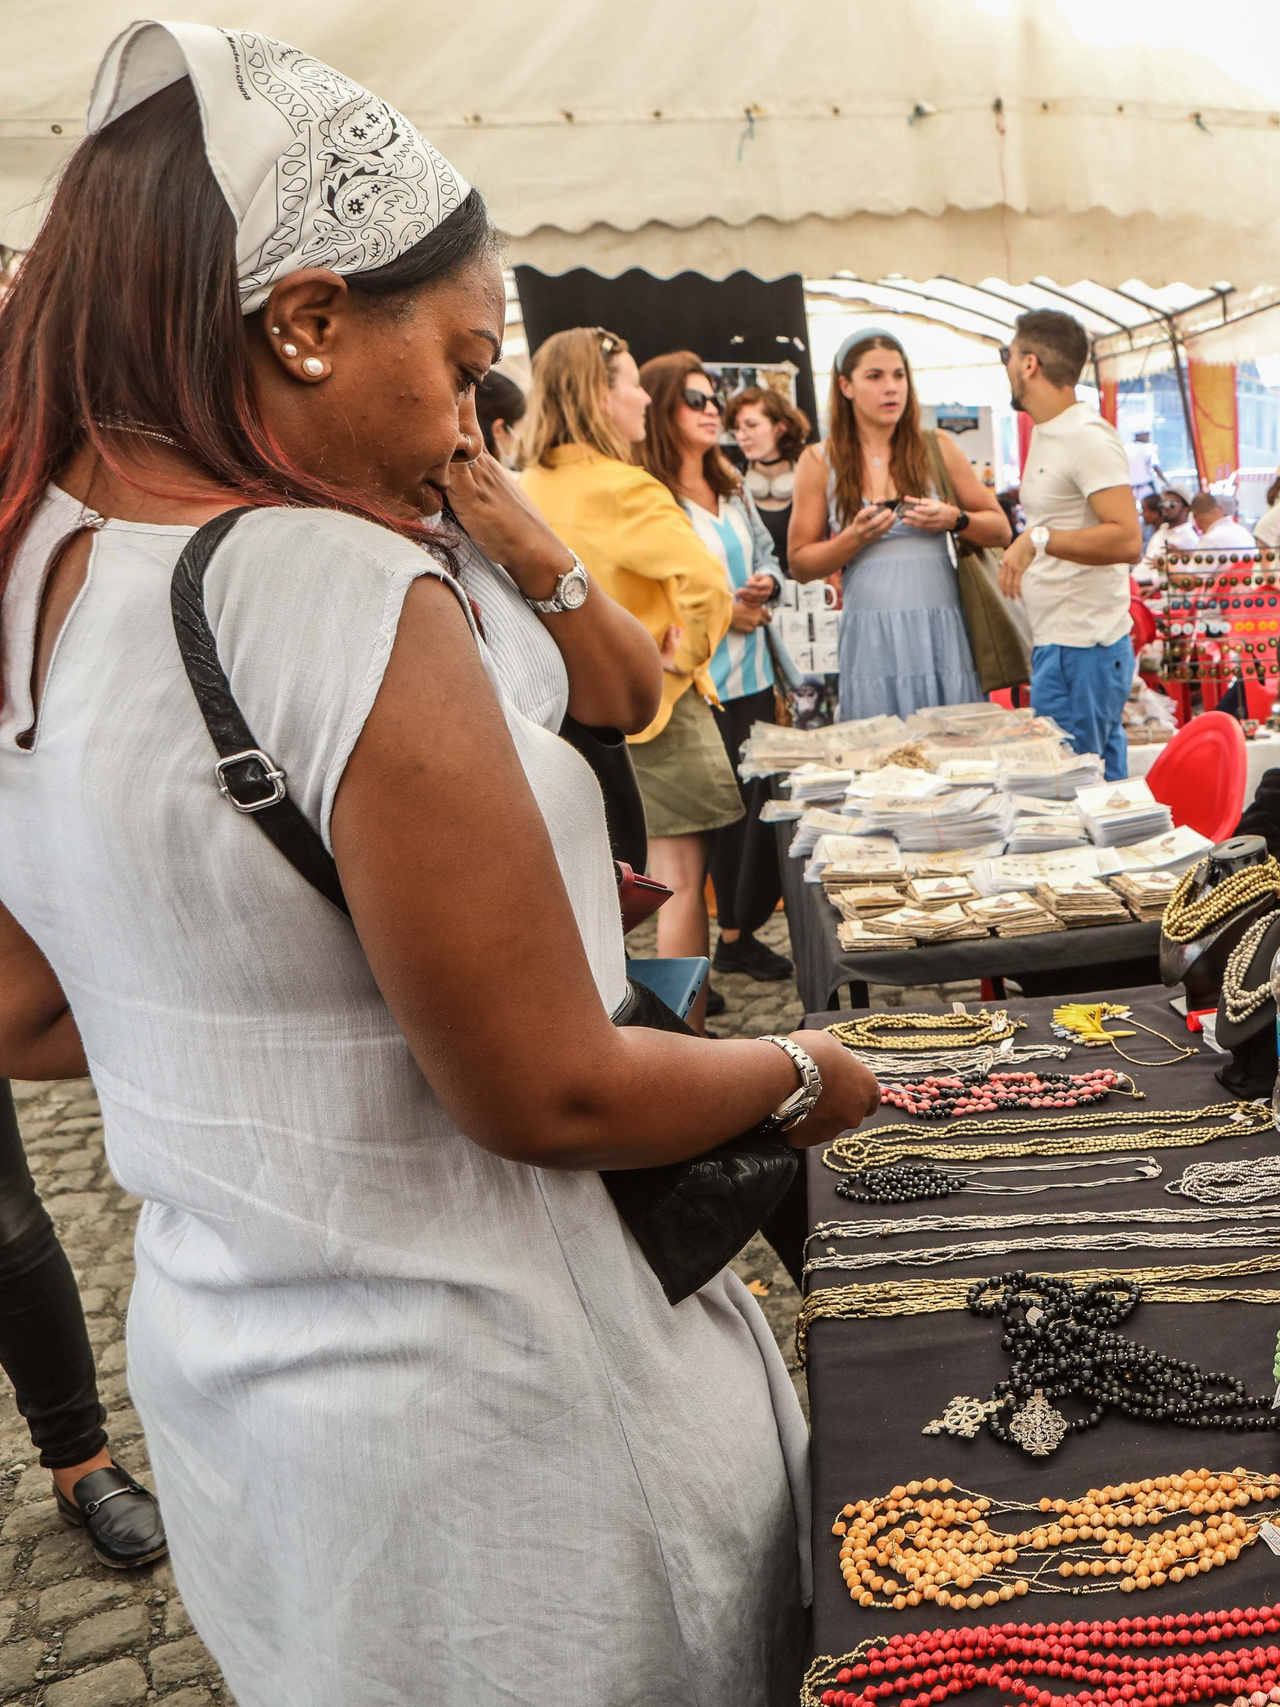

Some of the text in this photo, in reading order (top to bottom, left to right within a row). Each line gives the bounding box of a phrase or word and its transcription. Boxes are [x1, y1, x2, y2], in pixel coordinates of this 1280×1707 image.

[226, 36, 252, 101] Made in China
